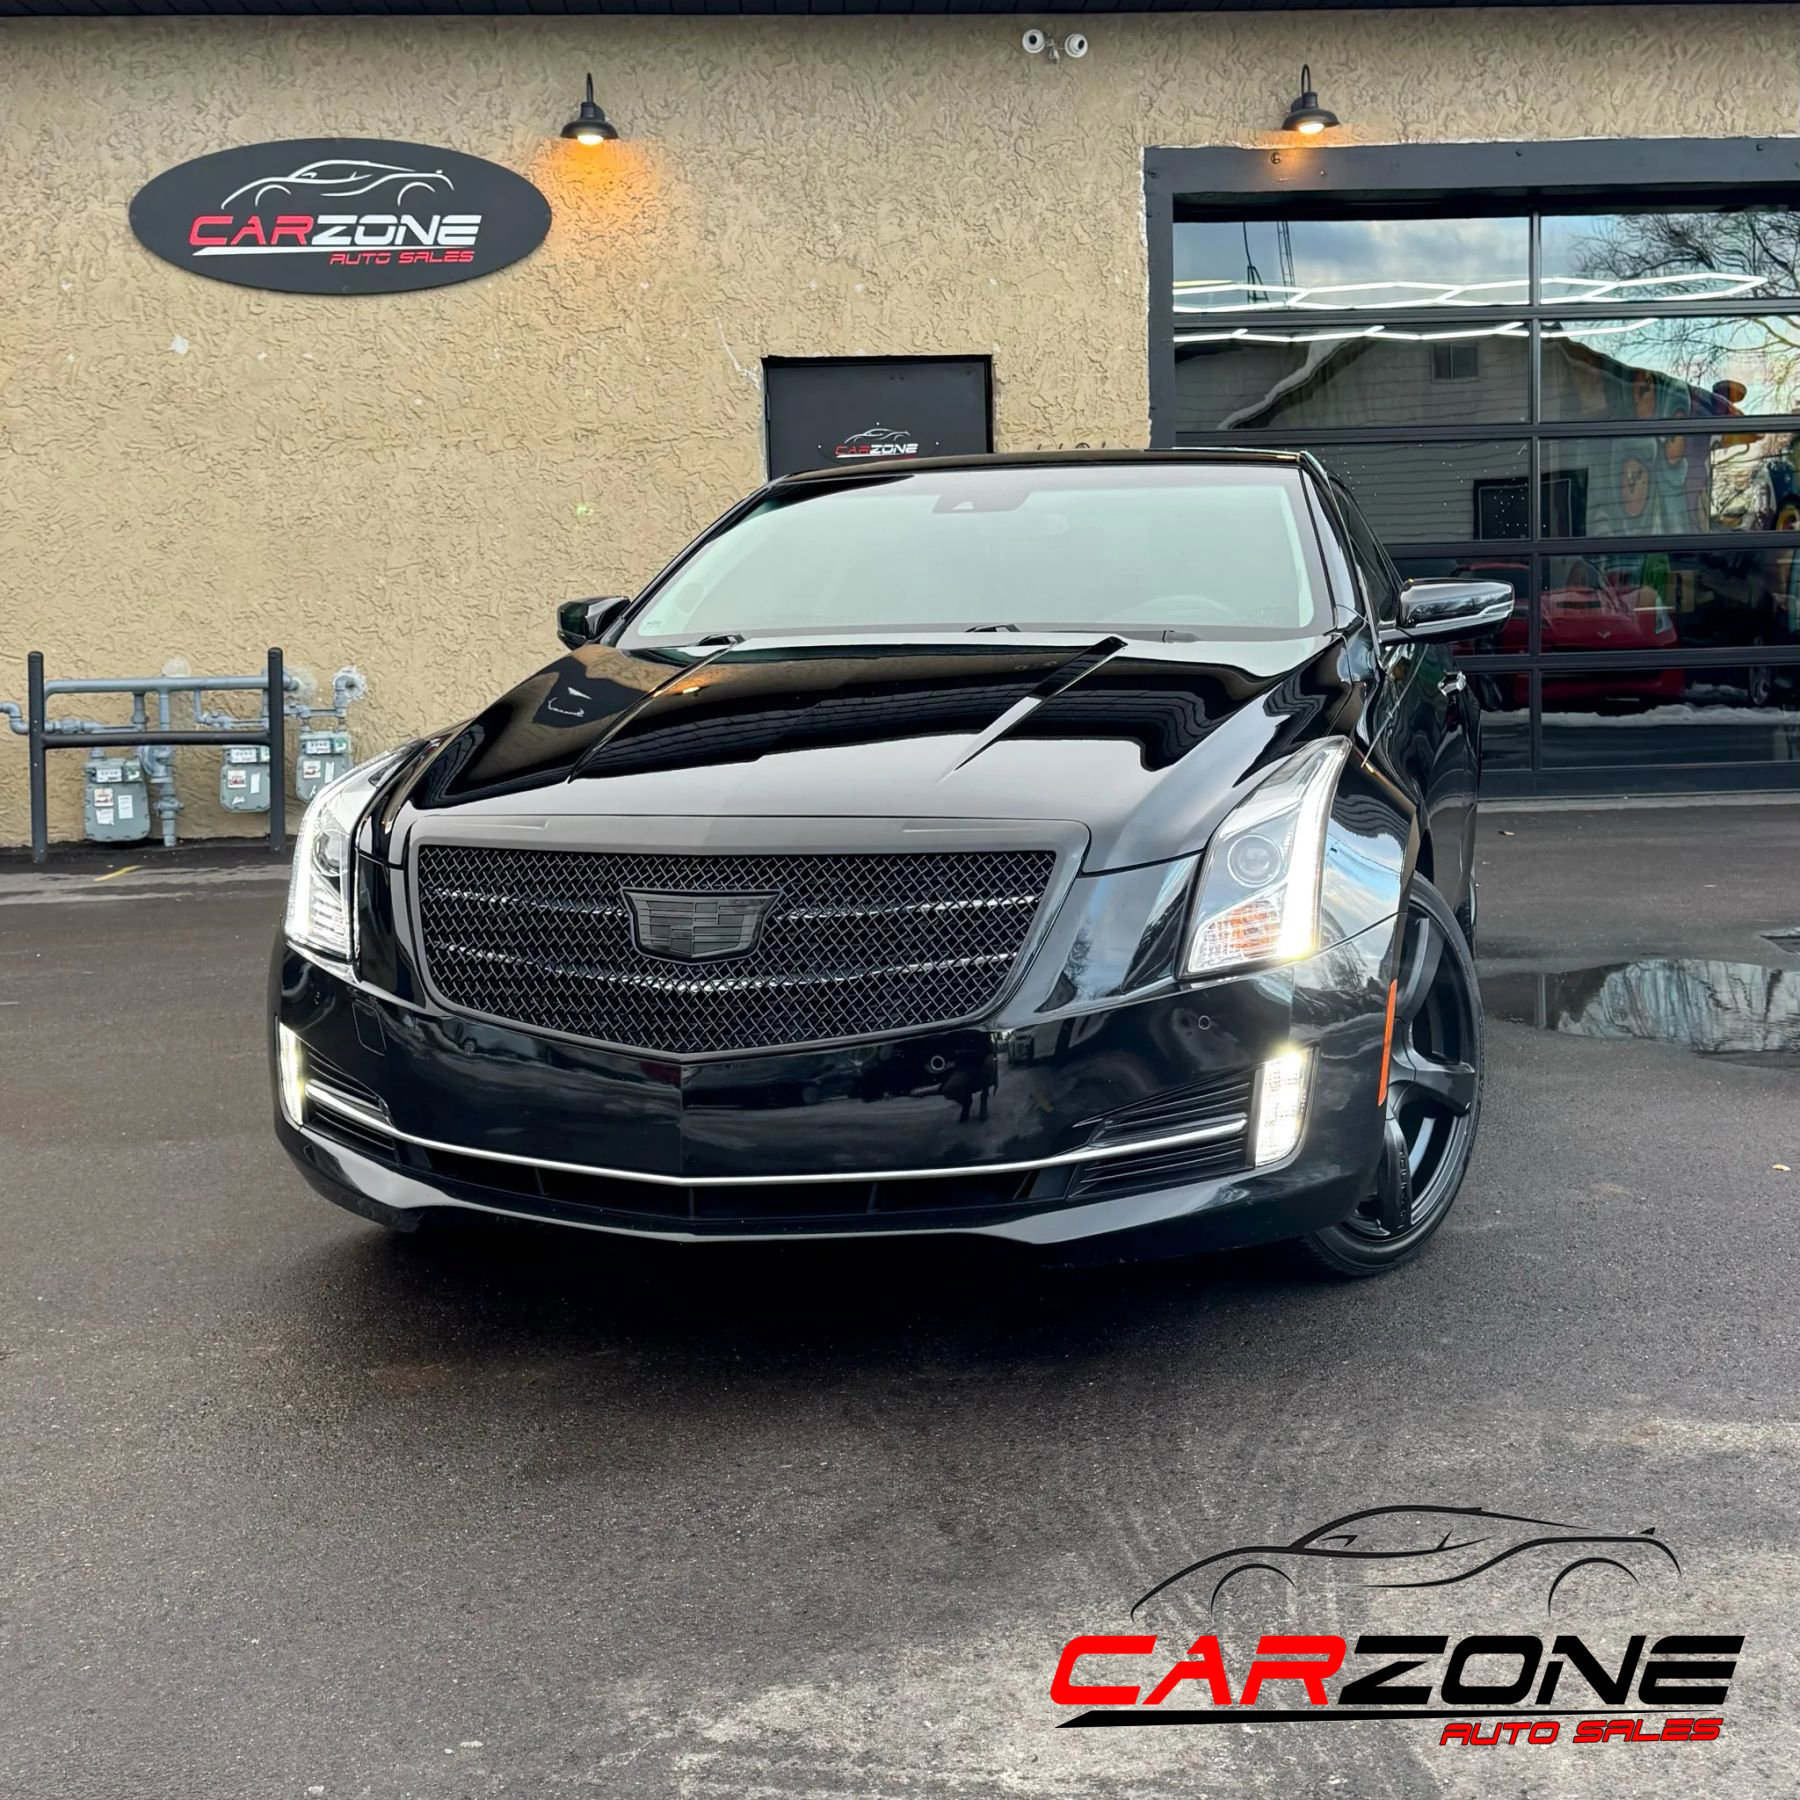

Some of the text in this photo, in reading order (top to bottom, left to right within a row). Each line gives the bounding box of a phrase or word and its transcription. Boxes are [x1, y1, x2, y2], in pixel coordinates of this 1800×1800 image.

[189, 215, 482, 245] CARZONE
[330, 250, 474, 264] AUTO SALES
